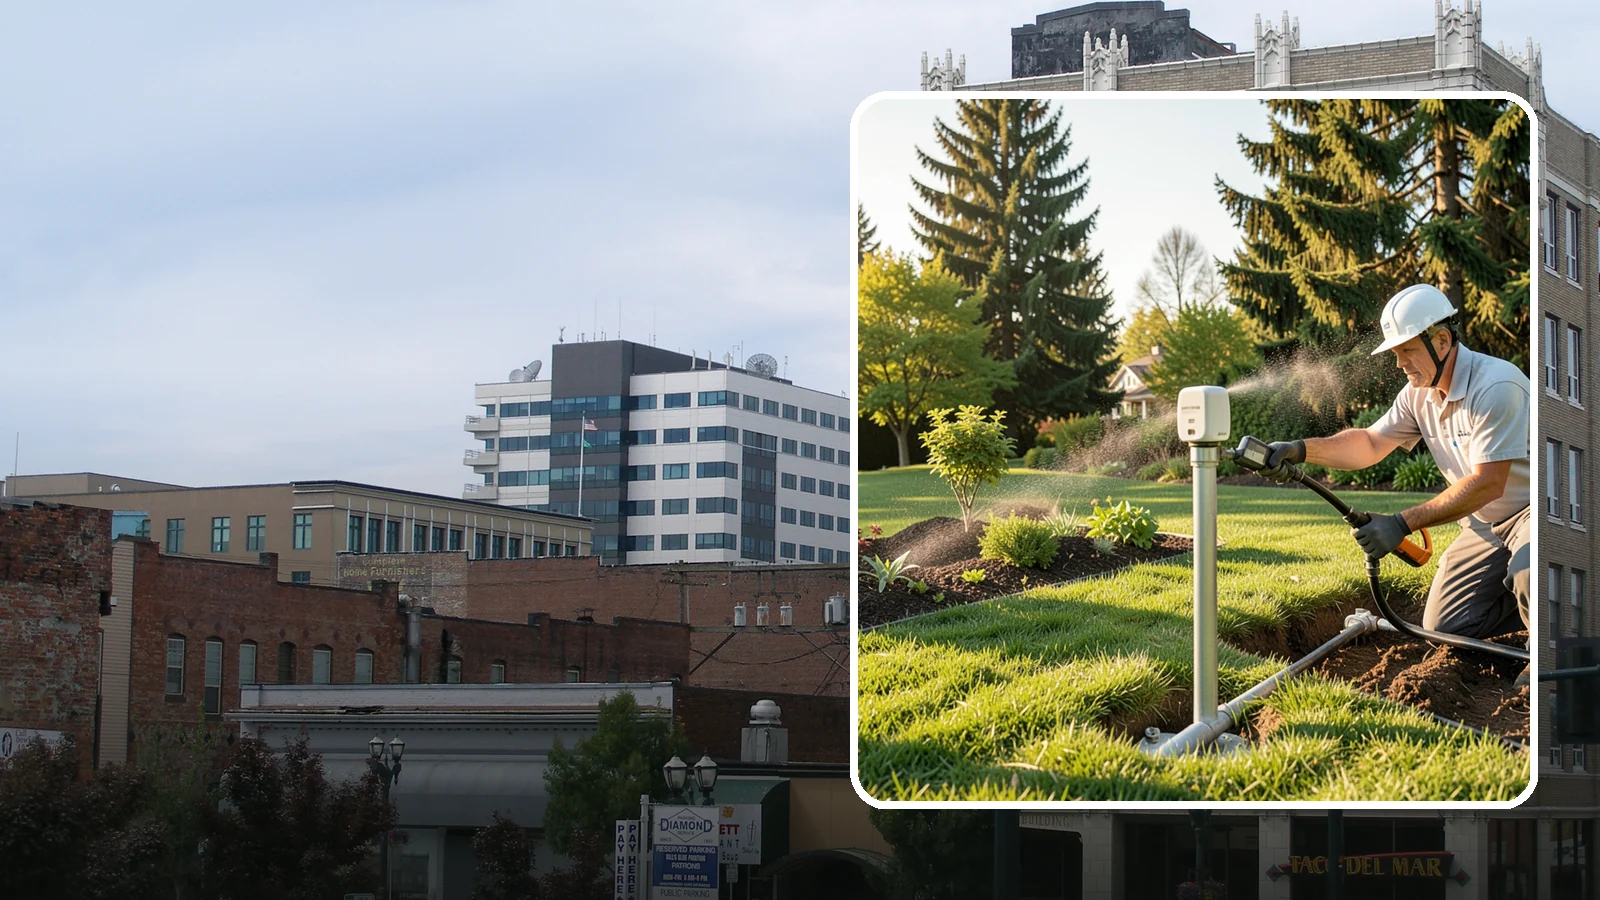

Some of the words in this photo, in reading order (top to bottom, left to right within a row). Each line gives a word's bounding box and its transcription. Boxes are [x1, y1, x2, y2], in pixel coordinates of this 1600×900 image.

[343, 568, 367, 577] Home
[370, 566, 427, 576] Furnishers
[660, 818, 713, 833] DIAMOND
[1021, 815, 1069, 827] BUILDING
[719, 824, 740, 835] ETT
[617, 824, 625, 852] PAY
[628, 824, 637, 852] PAY
[719, 839, 739, 848] ANT
[656, 845, 688, 853] RESERVED
[722, 851, 739, 862] Soup
[671, 862, 701, 870] PATRONS
[1289, 855, 1329, 874] TAC
[1346, 856, 1385, 876] DEL
[1392, 857, 1443, 877] MAR
[616, 856, 624, 893] HERE
[627, 856, 636, 893] HERE
[660, 888, 682, 897] PUBLIC
[683, 889, 710, 898] PARKING
